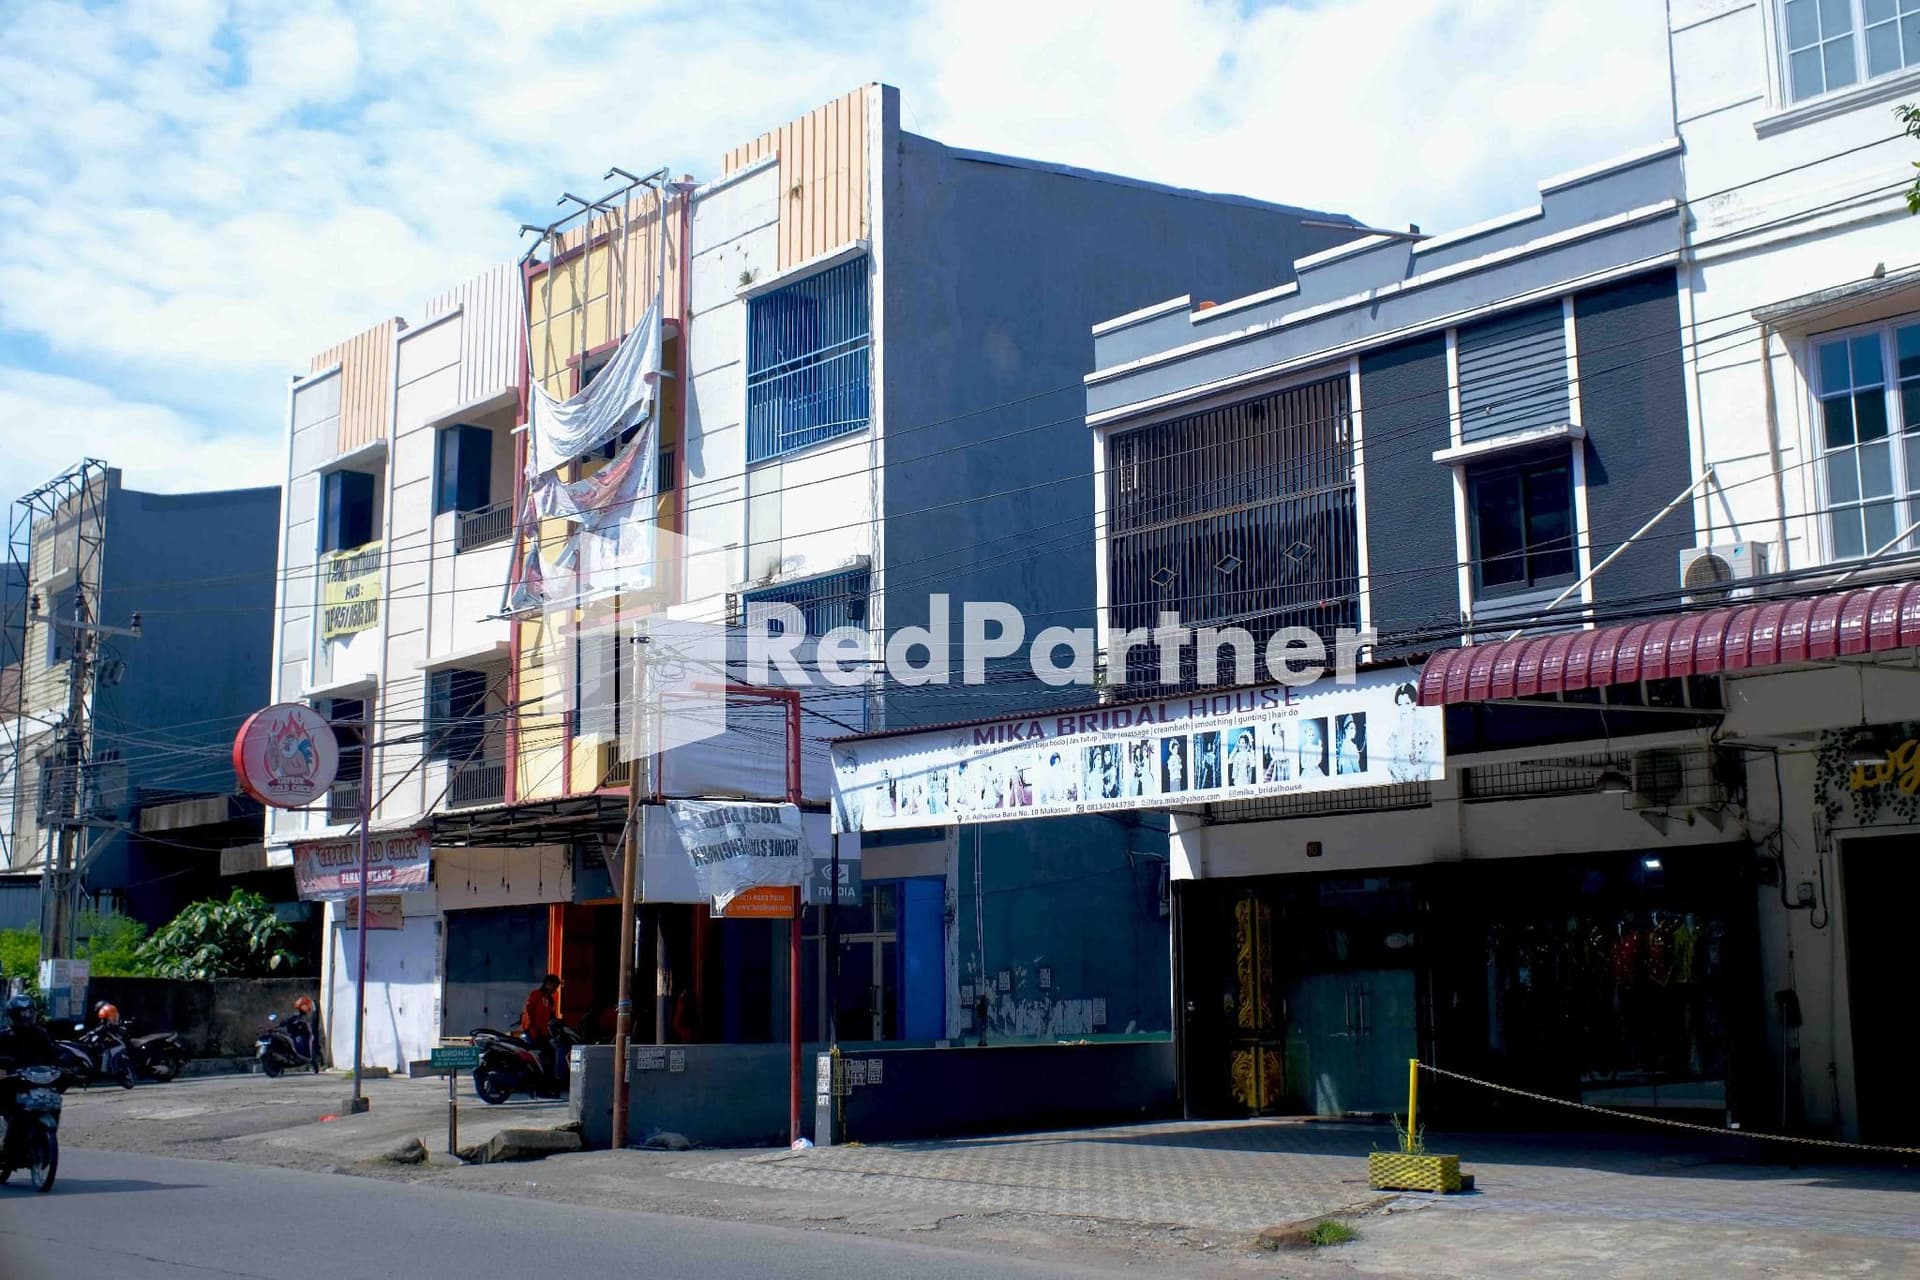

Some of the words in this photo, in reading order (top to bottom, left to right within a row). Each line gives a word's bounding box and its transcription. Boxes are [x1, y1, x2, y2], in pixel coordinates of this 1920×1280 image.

[973, 720, 1045, 746] MIKA
[1056, 703, 1175, 737] BRIDAL
[1188, 685, 1300, 719] HOUSE
[1153, 723, 1190, 735] creambath
[1194, 717, 1233, 730] smoothing
[1238, 713, 1267, 725] gunting
[1272, 709, 1287, 719] hair
[1288, 708, 1299, 717] do
[743, 807, 783, 825] KOST
[1002, 810, 1017, 818] Baru
[1040, 806, 1071, 816] Makassar
[435, 1050, 469, 1058] LORONG
